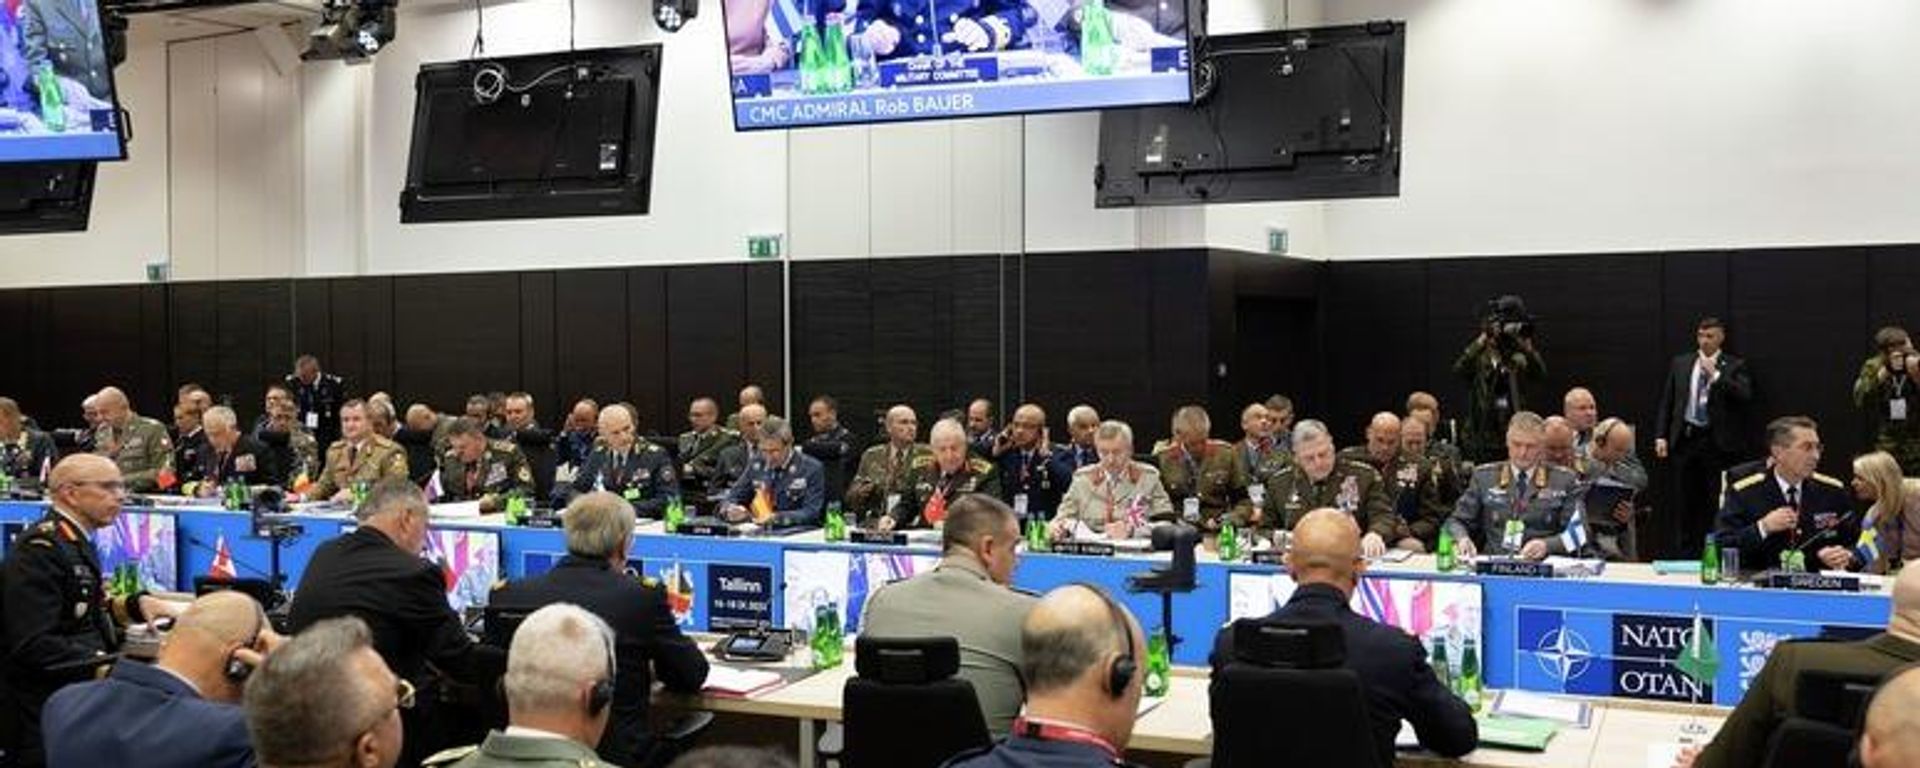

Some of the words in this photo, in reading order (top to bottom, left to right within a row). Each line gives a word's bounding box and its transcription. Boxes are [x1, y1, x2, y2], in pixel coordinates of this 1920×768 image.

[750, 105, 788, 122] CMC
[792, 99, 871, 120] ADMIRAL
[875, 98, 909, 115] Rob
[913, 93, 974, 112] BAUER
[1491, 563, 1537, 575] FINLAND
[718, 576, 762, 592] Tallinn
[1791, 574, 1842, 588] SWEDEN
[1620, 671, 1703, 697] OTAN
